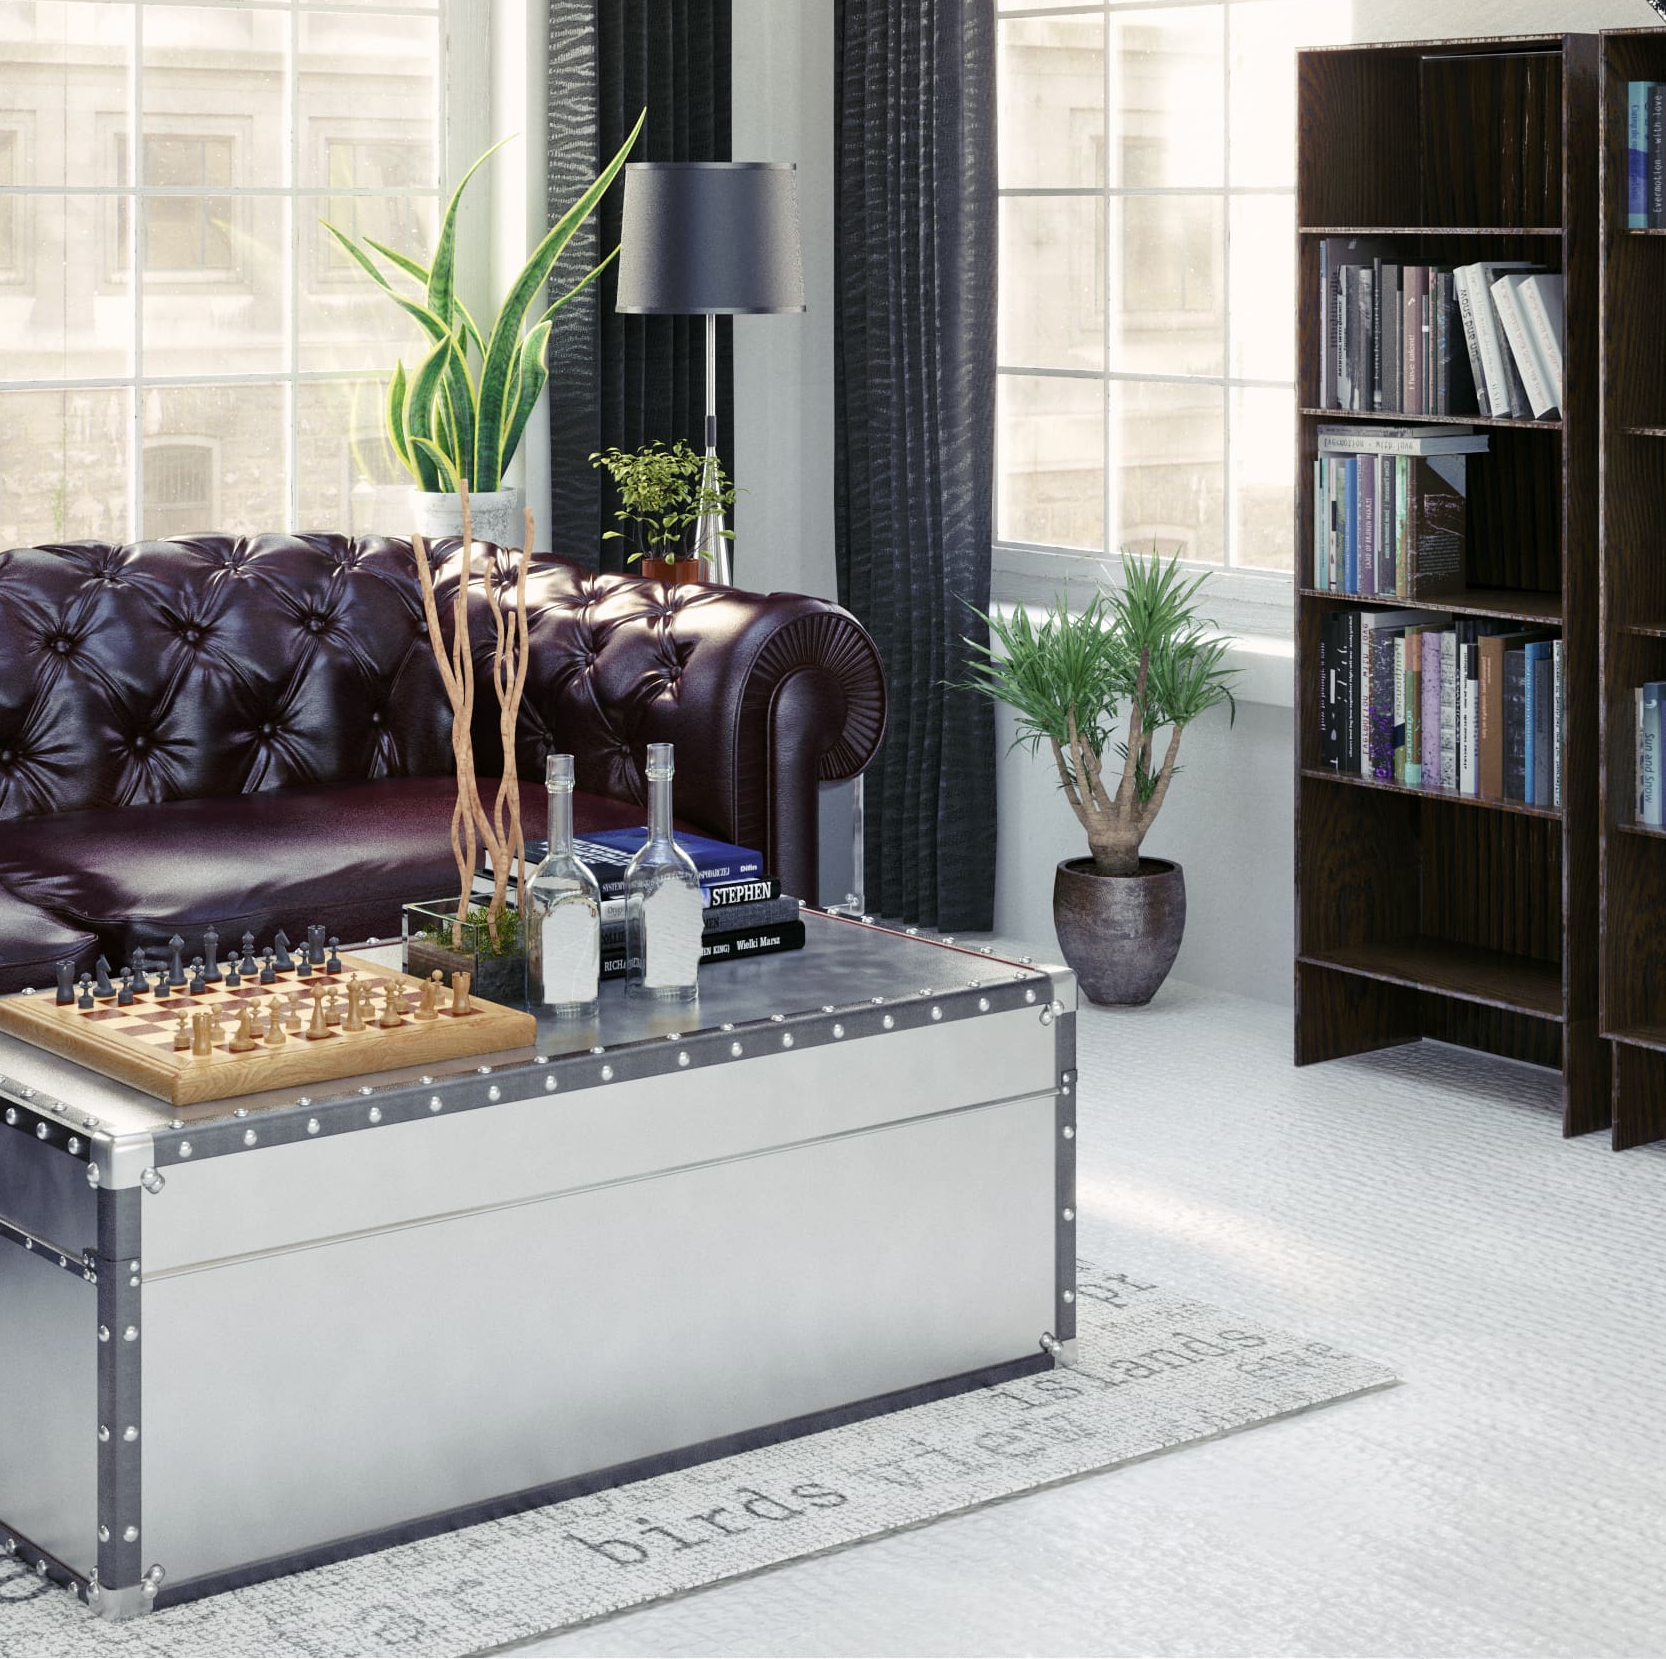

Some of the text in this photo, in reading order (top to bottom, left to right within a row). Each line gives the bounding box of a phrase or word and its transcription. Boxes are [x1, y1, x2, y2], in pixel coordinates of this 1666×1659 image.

[1653, 94, 1662, 213] Evermotion with love
[1645, 732, 1658, 804] Sun and Snow
[712, 881, 772, 907] STEPHEN
[736, 938, 758, 951] Wielki
[759, 935, 781, 948] Marsz
[561, 1471, 851, 1569] birds
